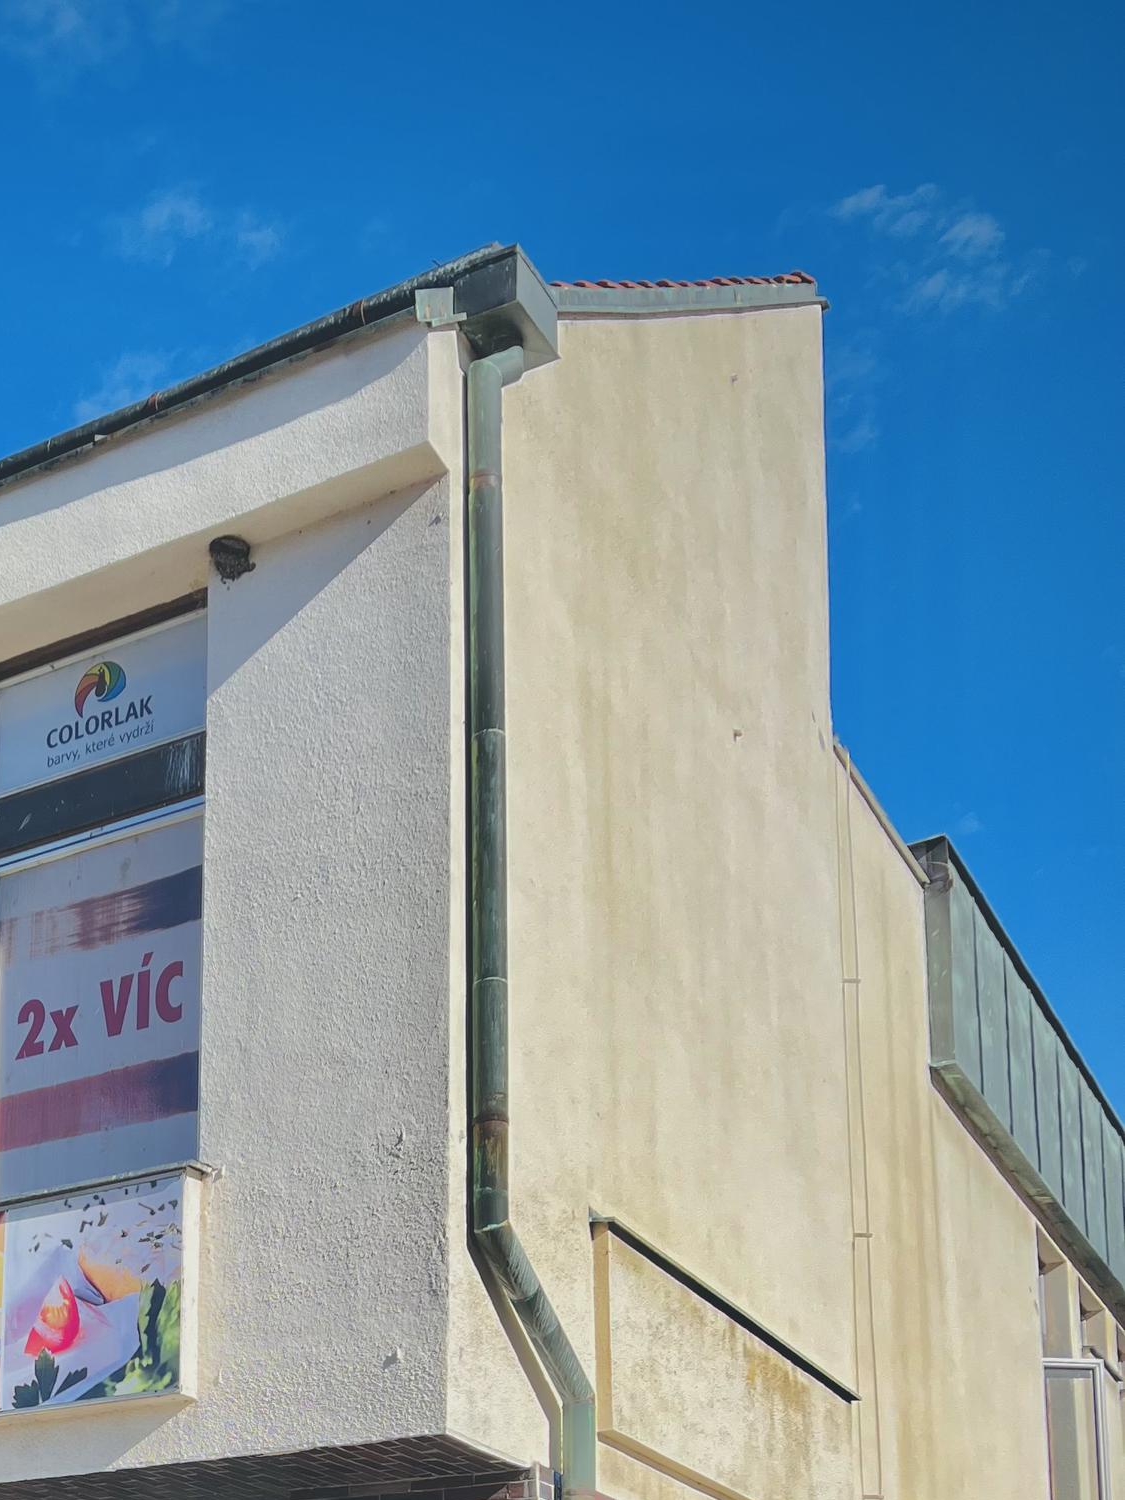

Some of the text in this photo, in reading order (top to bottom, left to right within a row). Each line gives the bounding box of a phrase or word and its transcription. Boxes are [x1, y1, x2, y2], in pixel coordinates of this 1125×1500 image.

[46, 695, 153, 748] COLORLAK
[47, 719, 155, 768] barvy, které vydrží
[15, 951, 184, 1061] 2x VÍC
